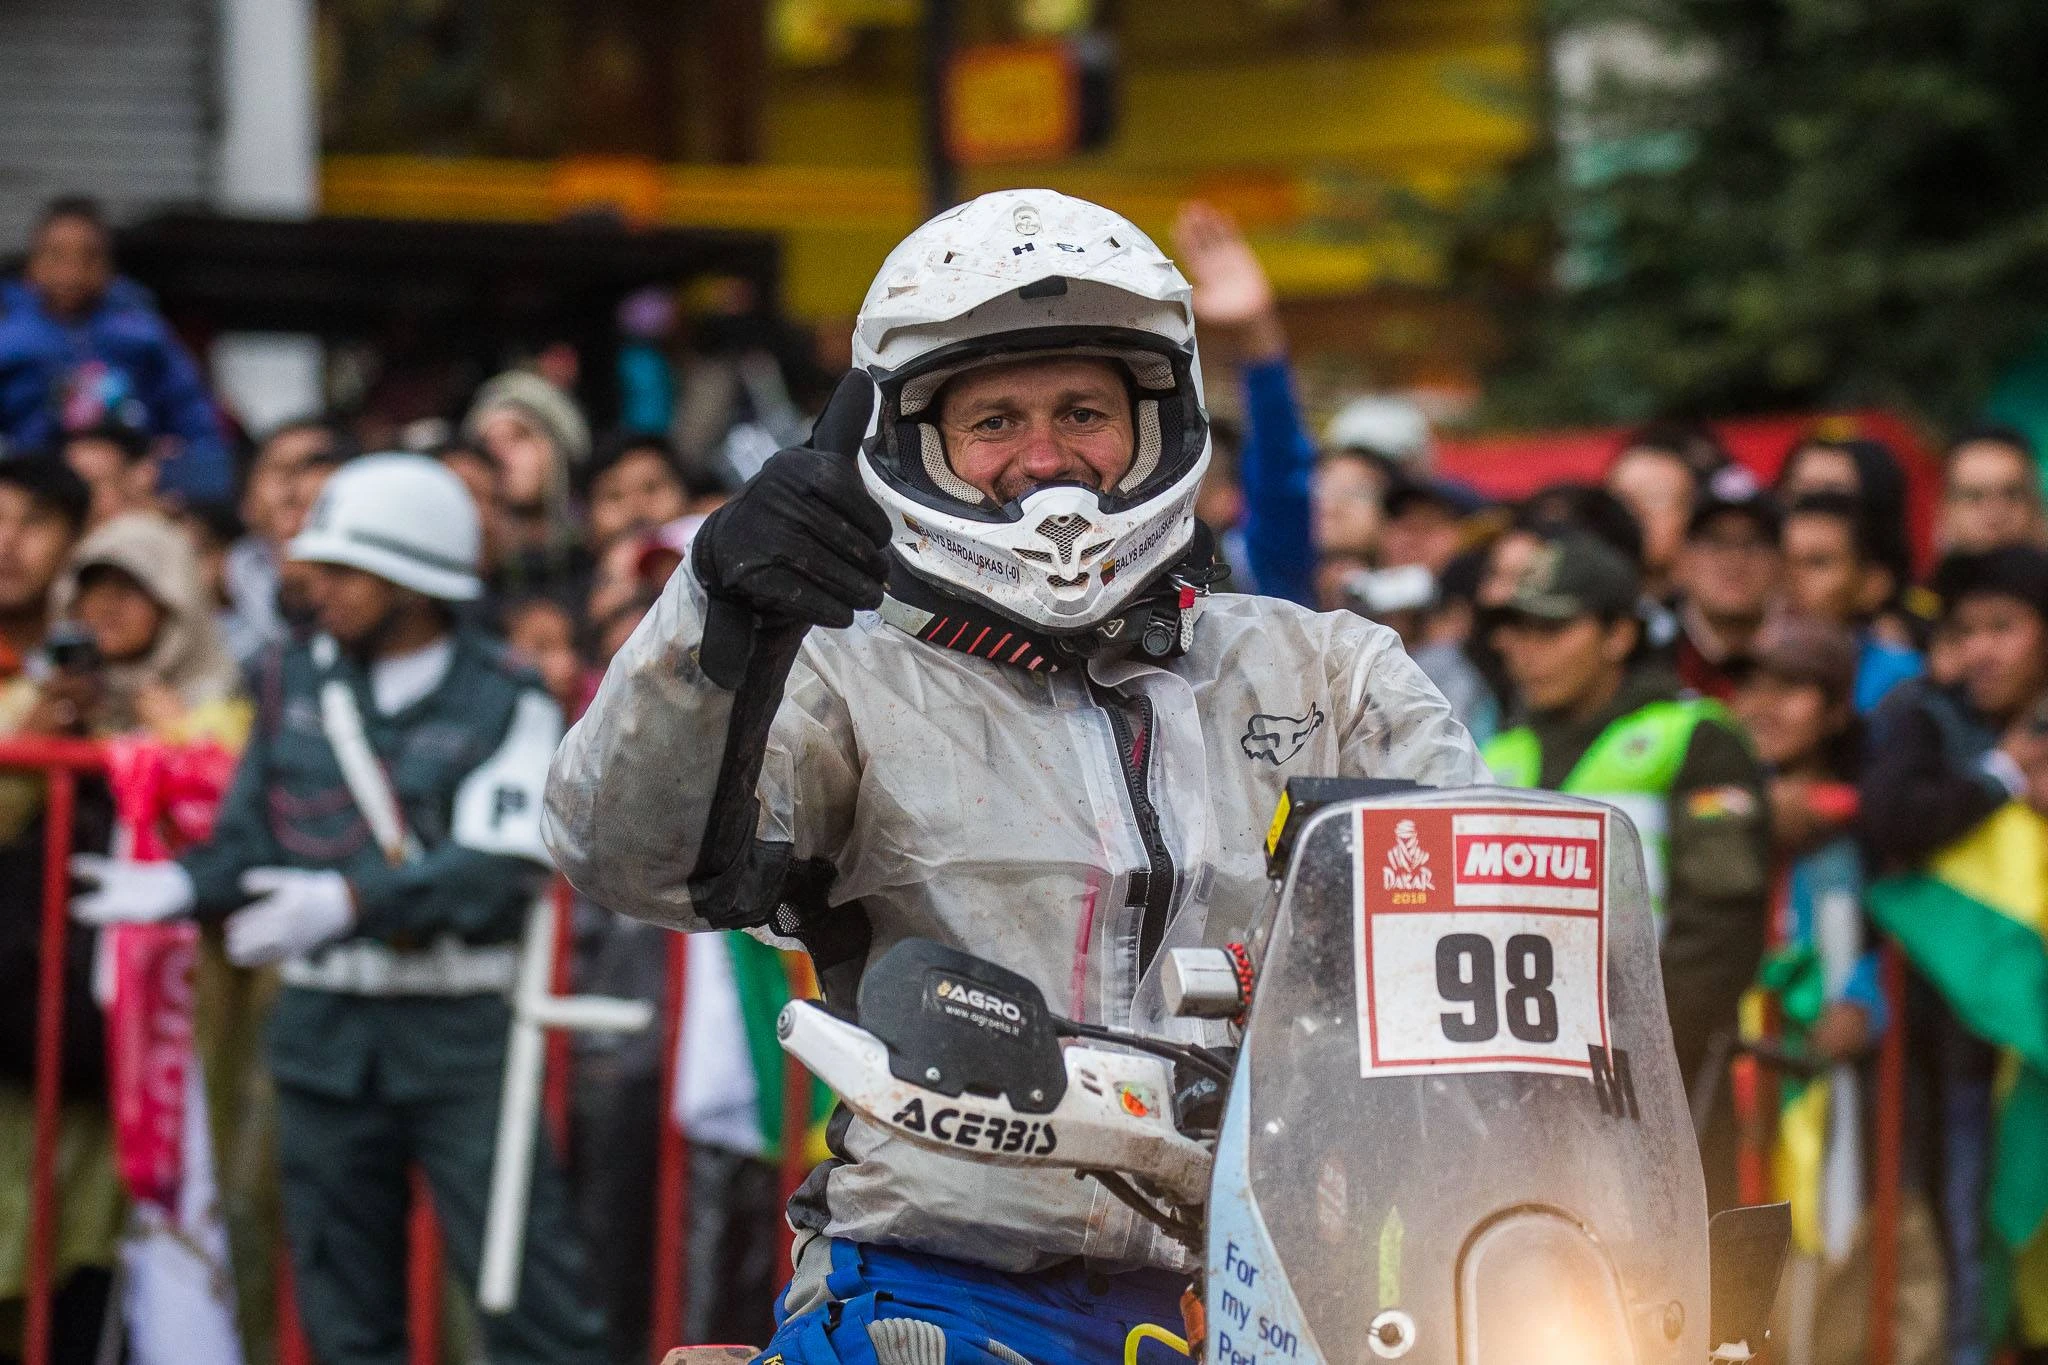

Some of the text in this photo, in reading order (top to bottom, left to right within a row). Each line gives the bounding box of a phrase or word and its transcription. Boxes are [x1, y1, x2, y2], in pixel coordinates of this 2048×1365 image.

[919, 525, 946, 548] BALYS
[946, 538, 1003, 575] BARDAUSKAS
[1115, 548, 1138, 573] BALYS
[1382, 866, 1436, 891] DAKAR
[1463, 842, 1592, 881] MOTUL
[1392, 892, 1427, 905] 2018
[948, 984, 1020, 1021] AGRO
[1435, 933, 1559, 1043] 98
[892, 1098, 1057, 1155] ACERBIS
[1226, 1241, 1259, 1288] For
[1222, 1289, 1298, 1358] my son
